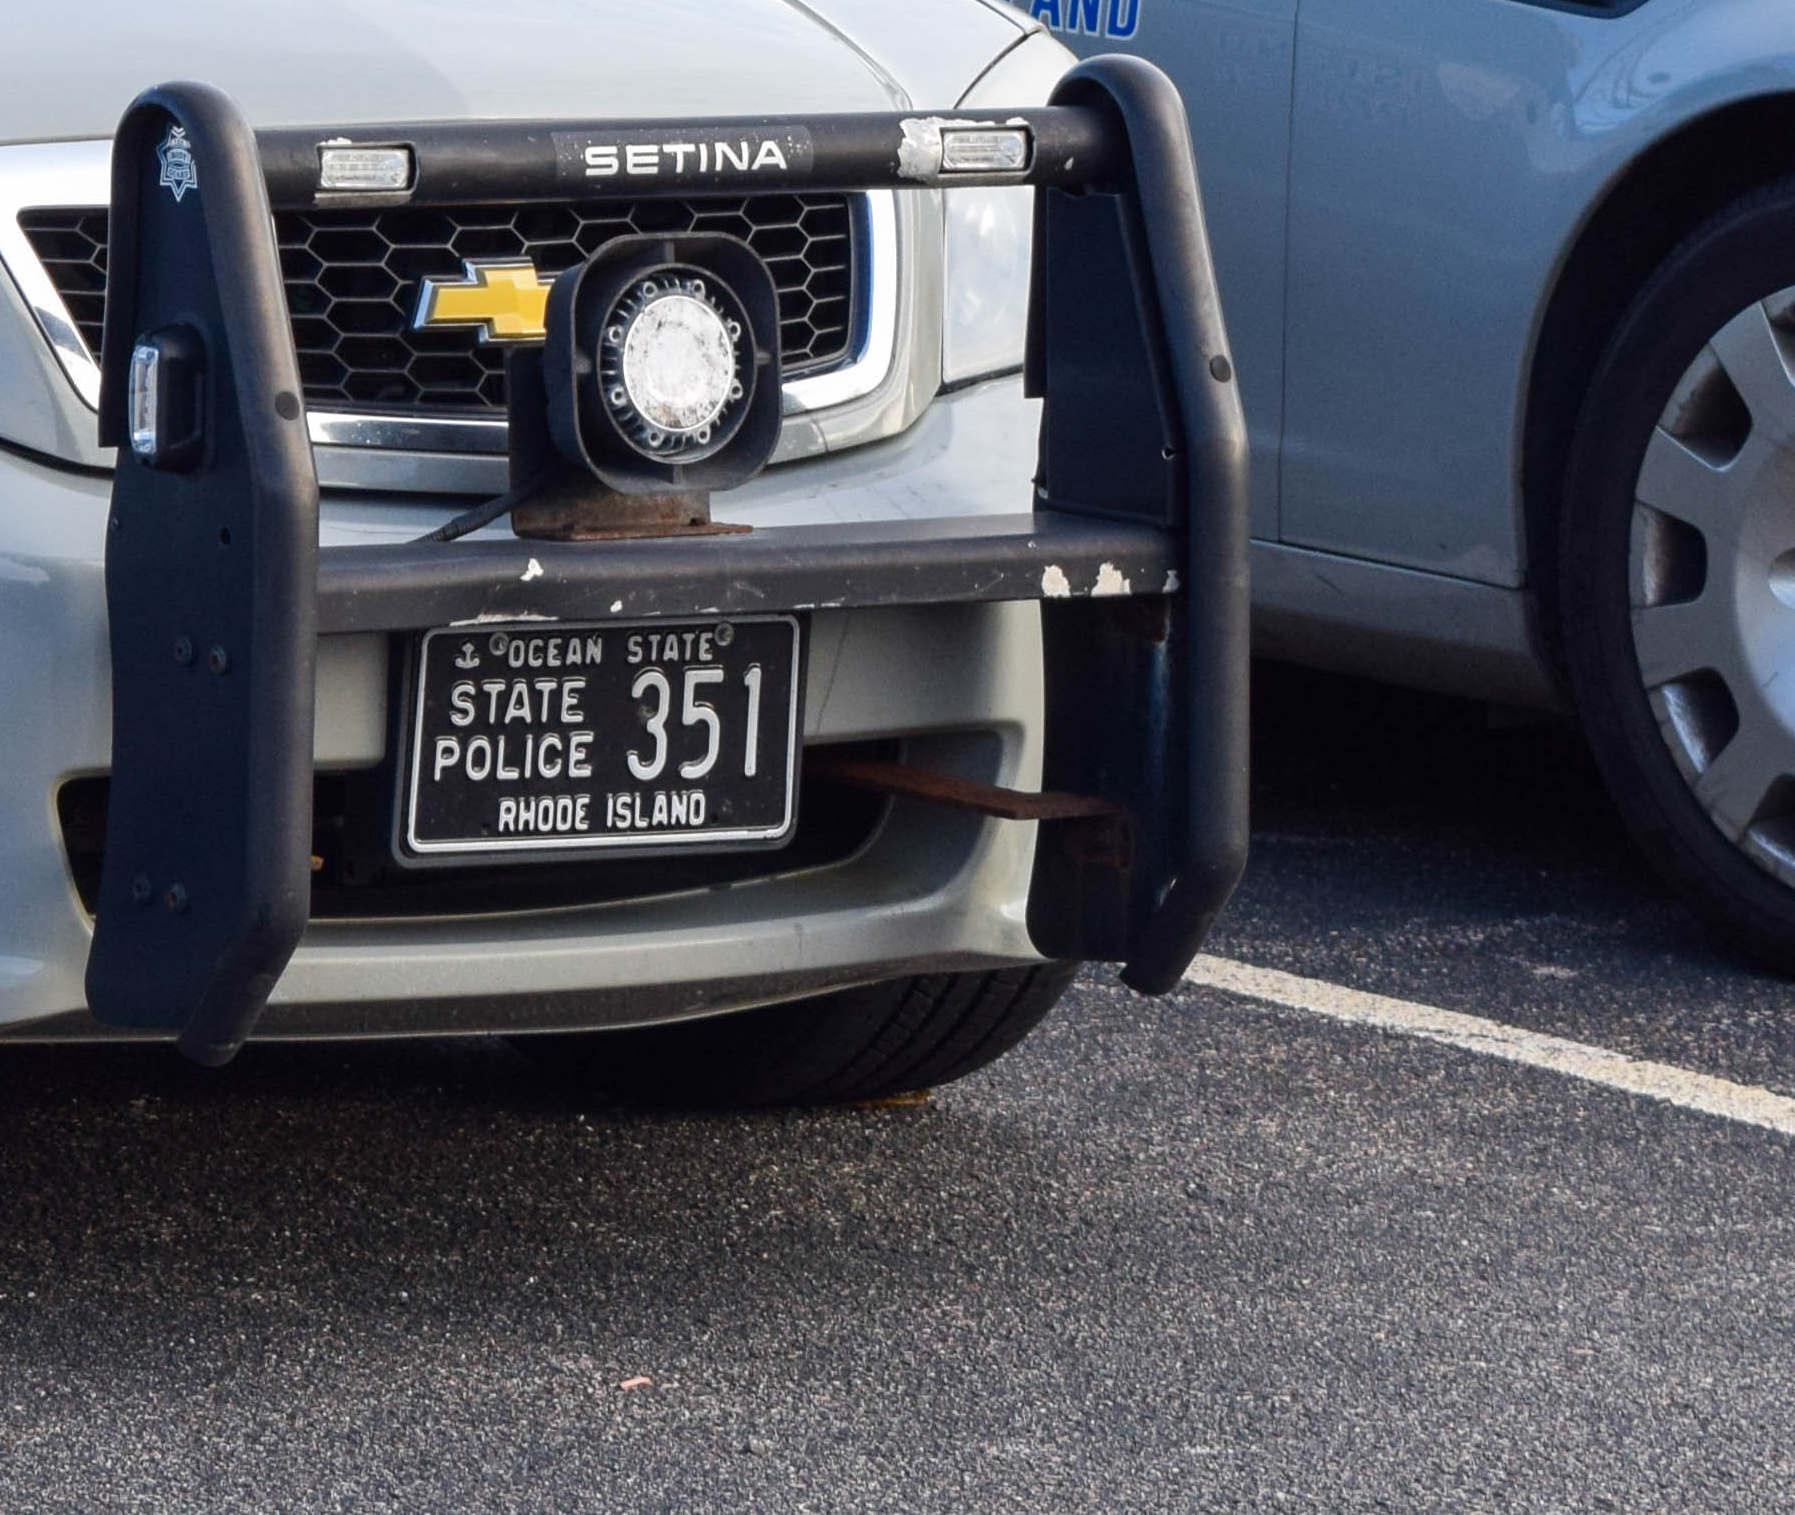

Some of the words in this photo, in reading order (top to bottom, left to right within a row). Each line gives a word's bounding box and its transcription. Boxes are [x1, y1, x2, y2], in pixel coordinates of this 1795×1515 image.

[585, 140, 788, 176] SETINA
[509, 636, 604, 668] OCEAN
[626, 632, 713, 664] STATE
[449, 678, 587, 726] STATE
[626, 664, 762, 781] 351
[433, 732, 594, 782] POLICE
[498, 795, 590, 833] RHODE
[606, 790, 707, 829] ISLAND
